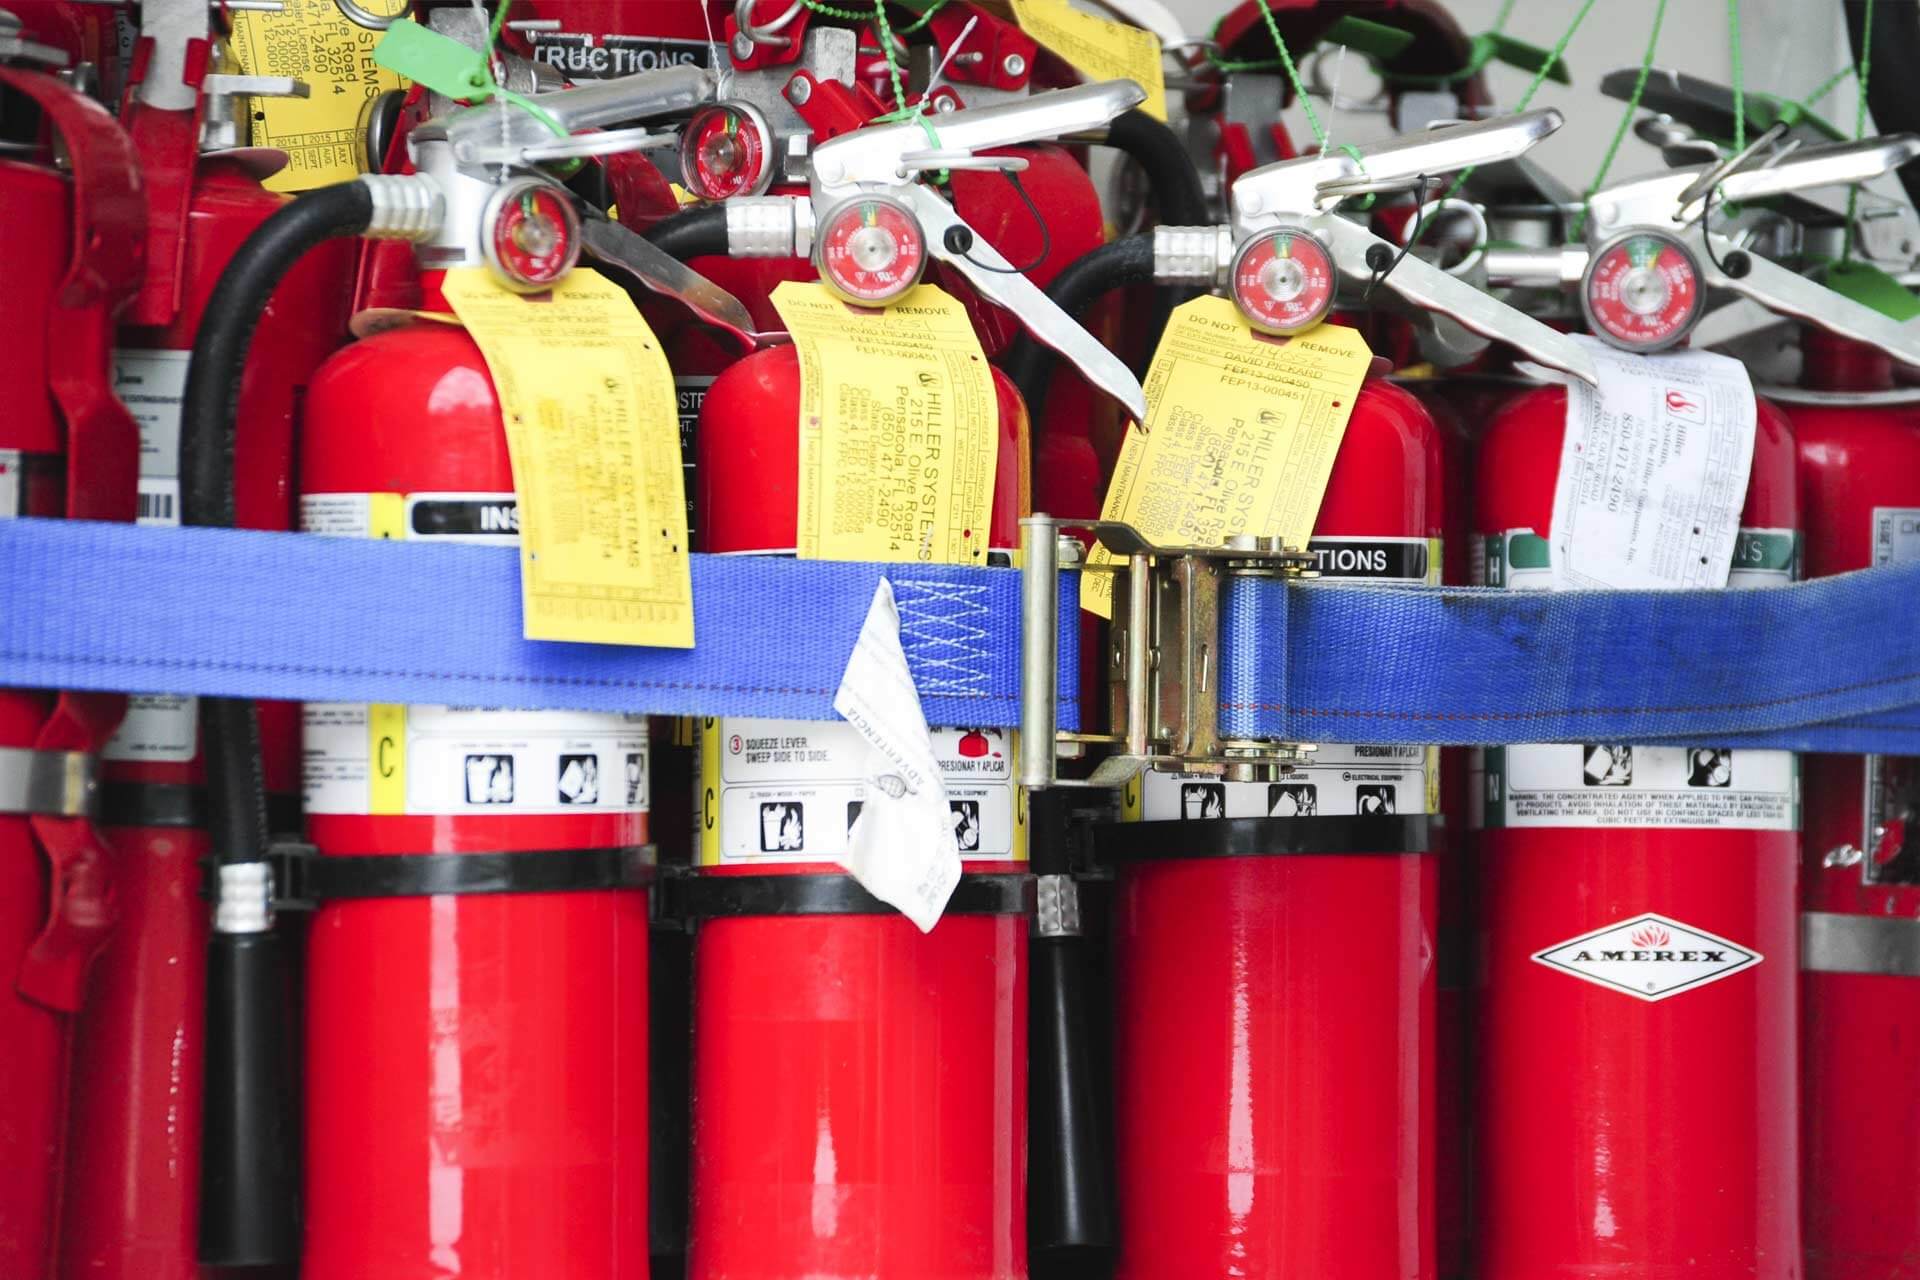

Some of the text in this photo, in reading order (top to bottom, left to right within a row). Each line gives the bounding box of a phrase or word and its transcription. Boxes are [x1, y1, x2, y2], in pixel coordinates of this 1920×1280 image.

[234, 19, 253, 74] MAINTENAN
[262, 27, 280, 76] 12-0001
[295, 26, 313, 72] License
[322, 21, 347, 96] FL 32514
[340, 40, 359, 83] Road
[355, 31, 382, 100] STEMS
[276, 138, 298, 147] 2014
[309, 135, 332, 144] 2015
[895, 305, 951, 316] REMOVE
[1189, 314, 1356, 359] DO NOT REMOVE
[1224, 352, 1325, 380] DAVID PICKARD
[1220, 375, 1306, 400] FEP13-000451
[907, 398, 923, 428] 215
[1124, 440, 1140, 462] NEW
[1234, 429, 1255, 458] 215
[1674, 424, 1688, 456] Hiller
[874, 406, 896, 528] (850) 471-2490
[906, 454, 920, 495] Olive
[918, 392, 942, 561] HILLER SYSTEMS
[1226, 427, 1276, 537] HILLER SYST
[1604, 411, 1635, 515] 850-471-2490
[892, 478, 905, 497] FL
[1105, 463, 1133, 520] MAINTENANCE
[1130, 476, 1159, 531] 12-00012
[1175, 430, 1224, 539] (850) 471-2490
[1214, 476, 1238, 516] Olive
[887, 502, 903, 551] 32514
[901, 500, 917, 541] Road
[1189, 493, 1217, 545] FL 325
[1203, 515, 1225, 547] Roa
[378, 736, 394, 778] C
[843, 706, 927, 787] ADVERTENCIA
[704, 788, 714, 829] C
[1572, 950, 1727, 963] AMEREX
